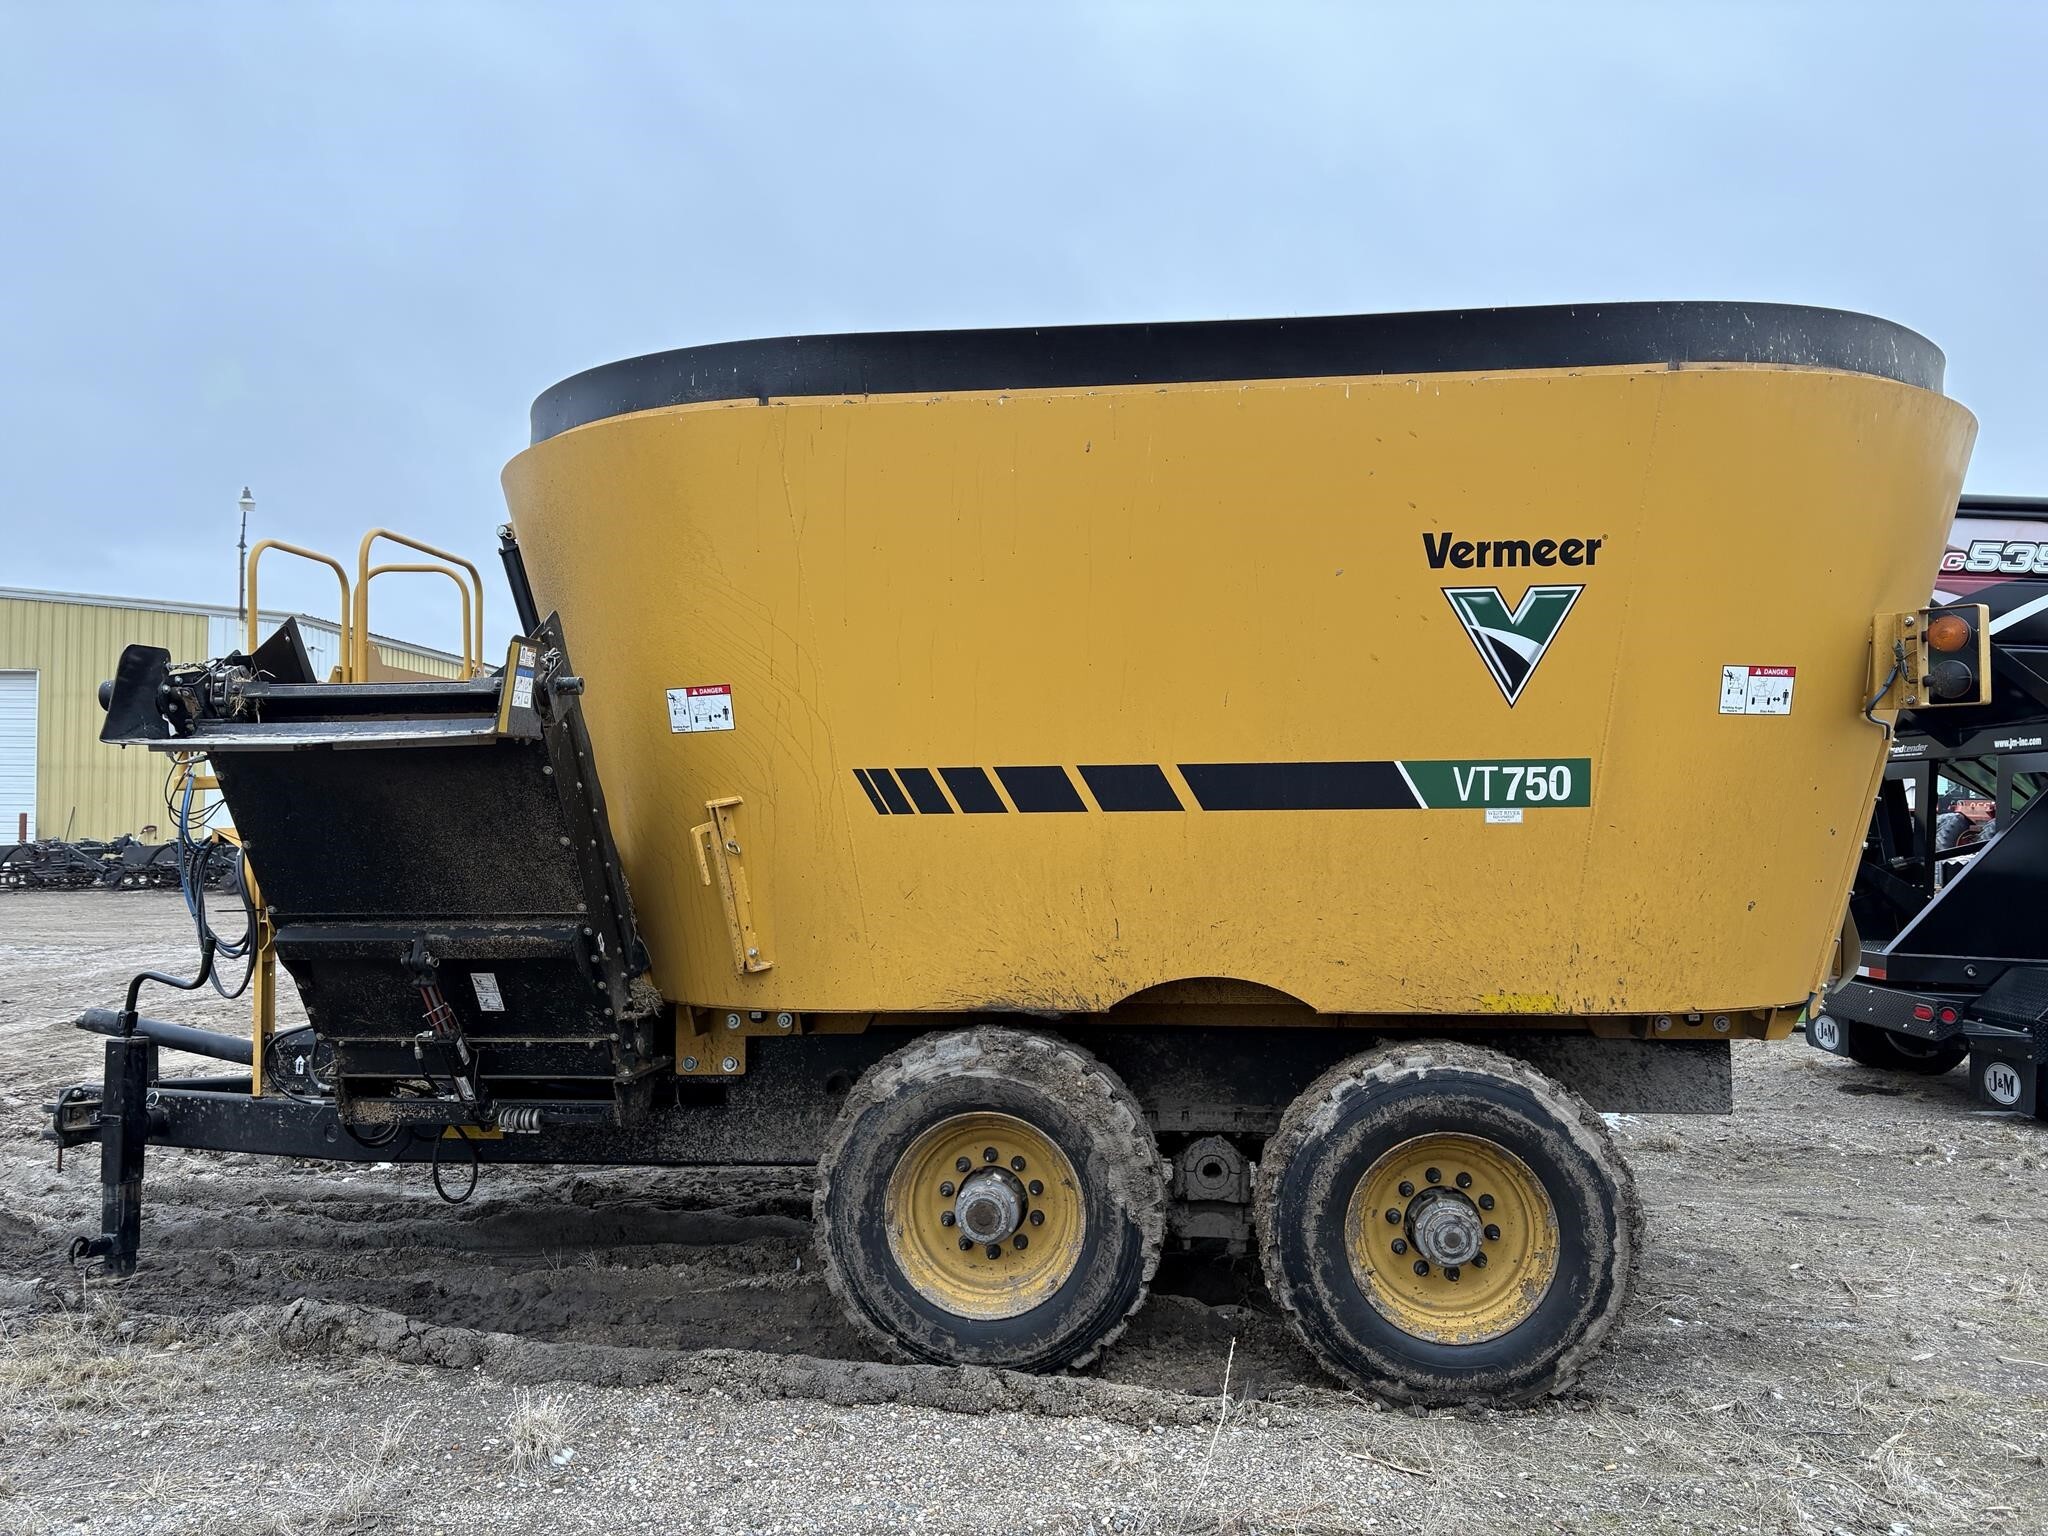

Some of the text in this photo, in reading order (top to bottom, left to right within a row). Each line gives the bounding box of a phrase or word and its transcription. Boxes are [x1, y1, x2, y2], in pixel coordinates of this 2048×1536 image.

[1422, 532, 1602, 569] Vermeer
[1763, 668, 1789, 676] DANGER
[699, 687, 723, 695] DANGER
[1452, 765, 1572, 802] VT 750
[1817, 1021, 1836, 1044] J&M
[1988, 1070, 2015, 1098] J&M
